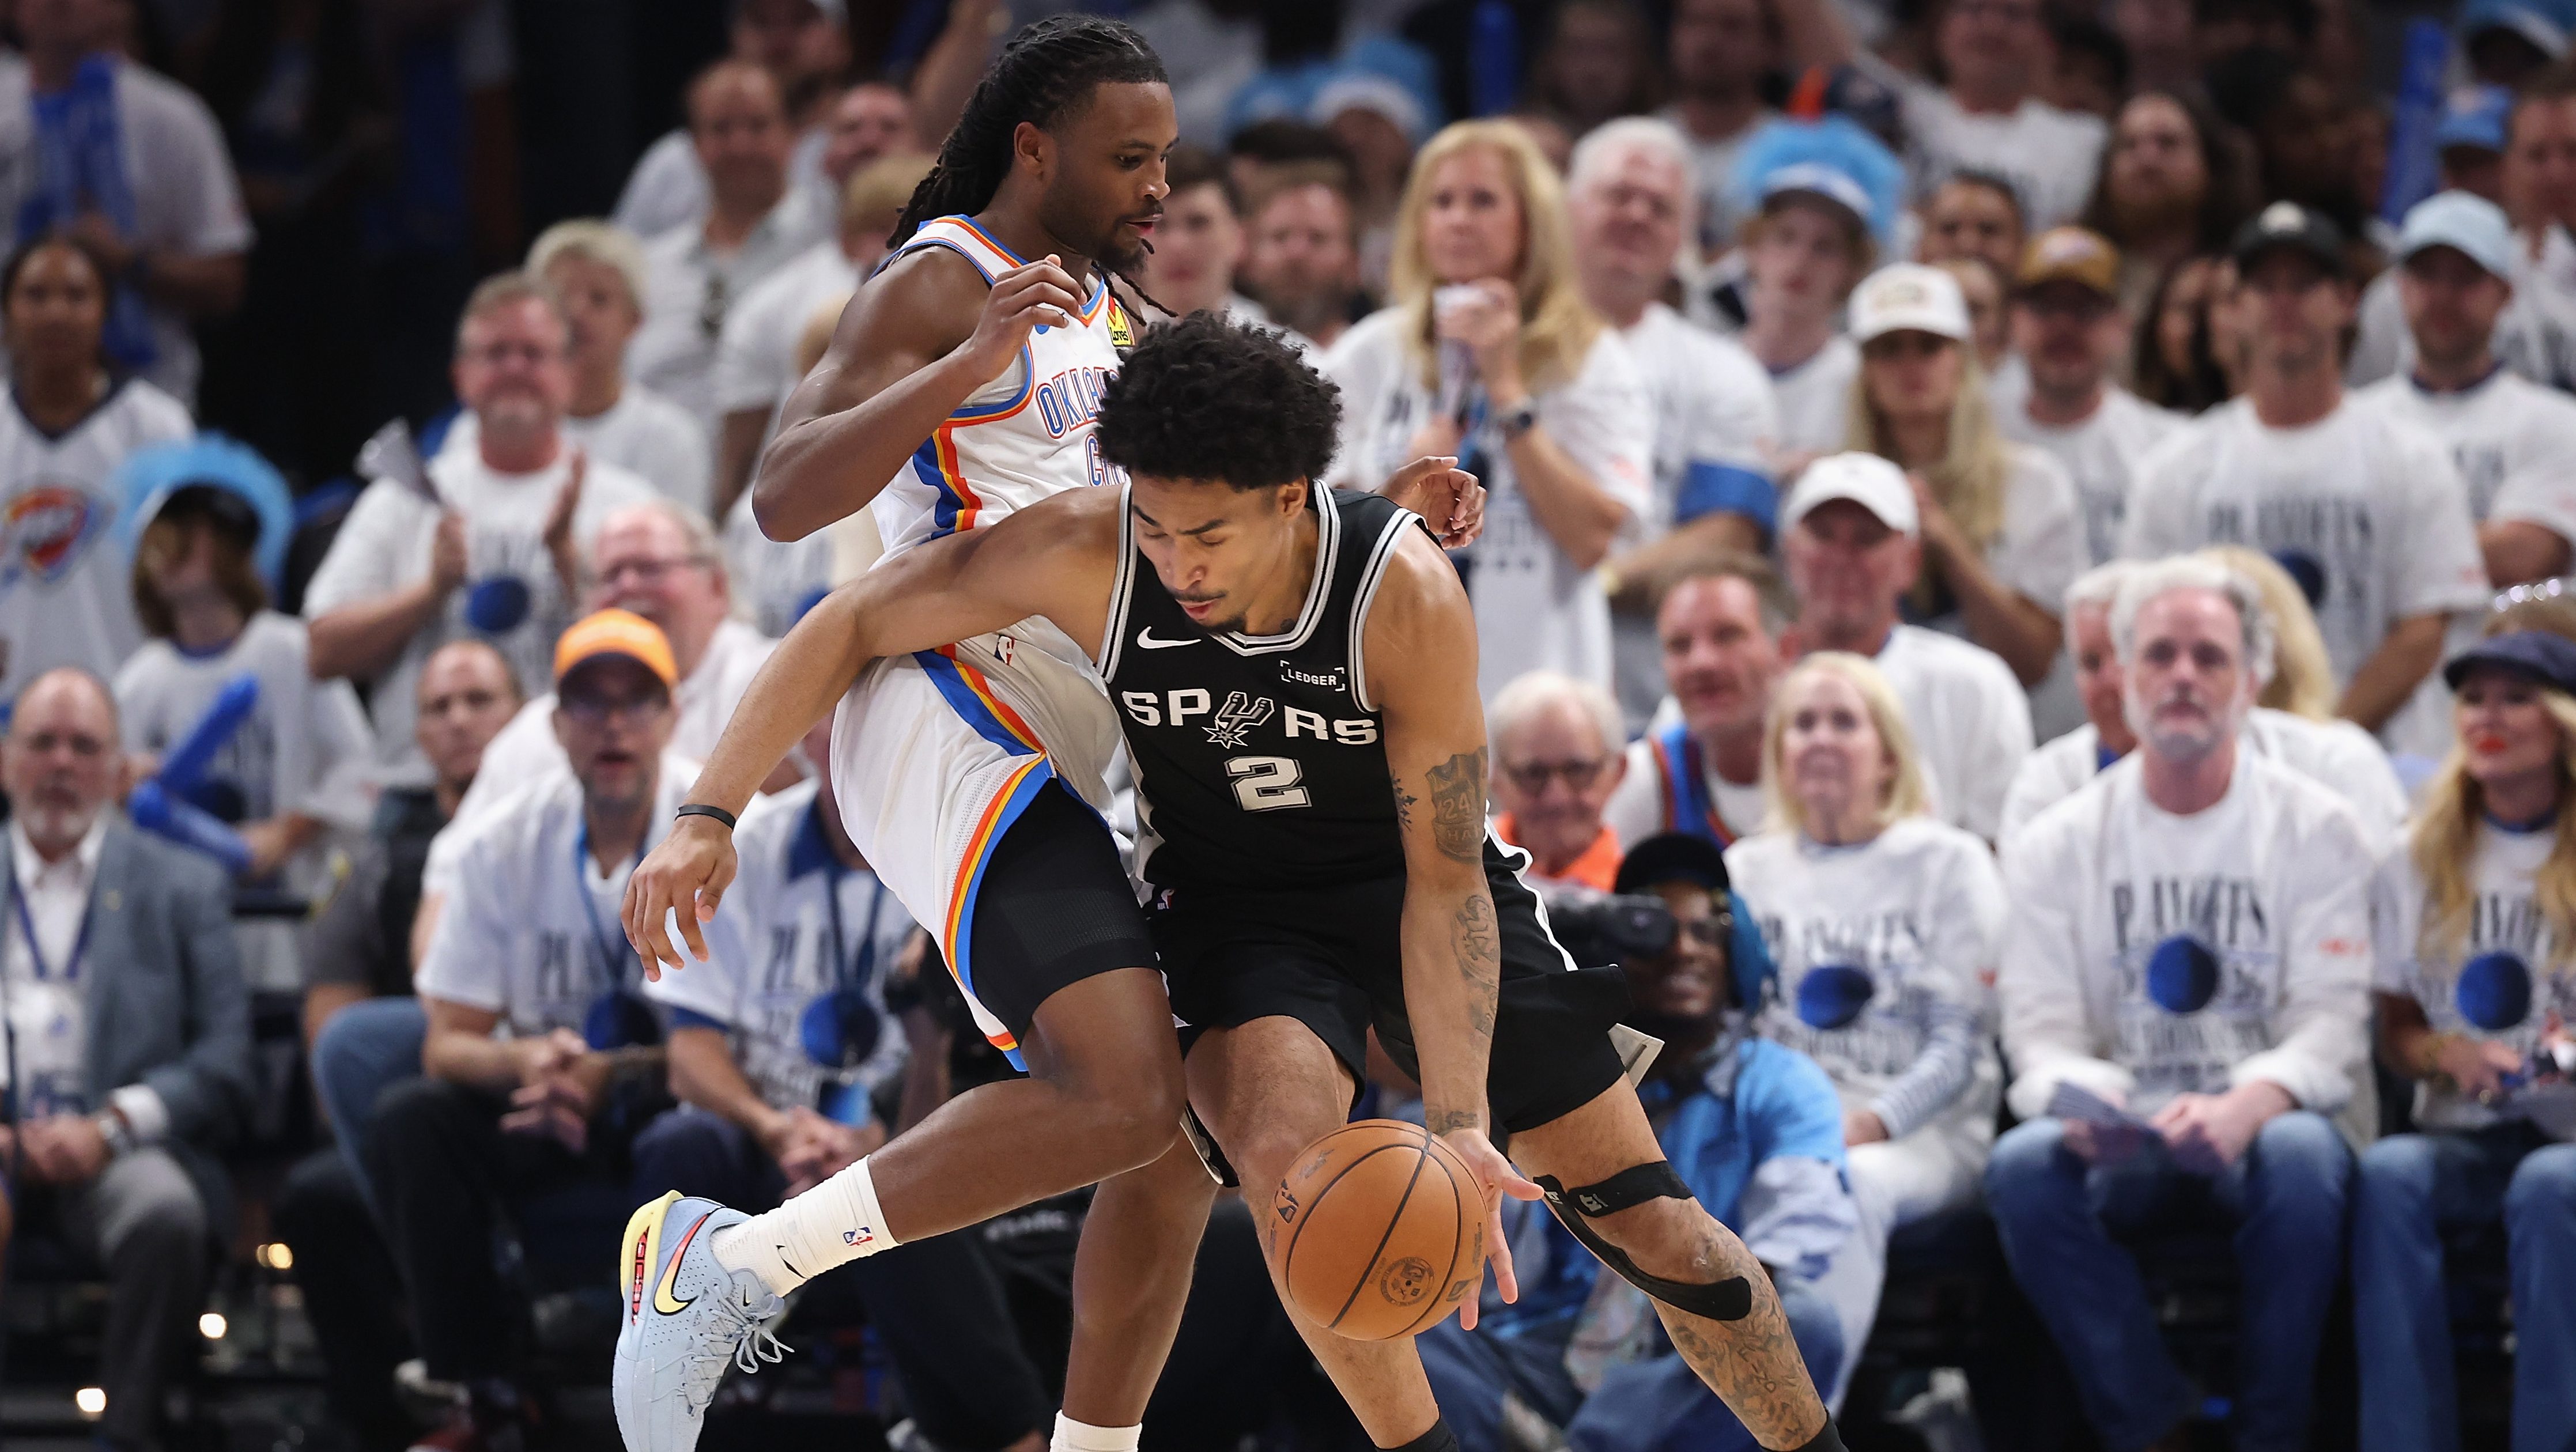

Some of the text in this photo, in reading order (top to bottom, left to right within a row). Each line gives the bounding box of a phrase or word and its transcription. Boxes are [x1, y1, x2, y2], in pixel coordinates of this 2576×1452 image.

[1287, 668, 1337, 686] LEDGER
[1121, 688, 1378, 749] SPURS
[1223, 755, 1312, 813] 2
[1442, 792, 1471, 820] 24
